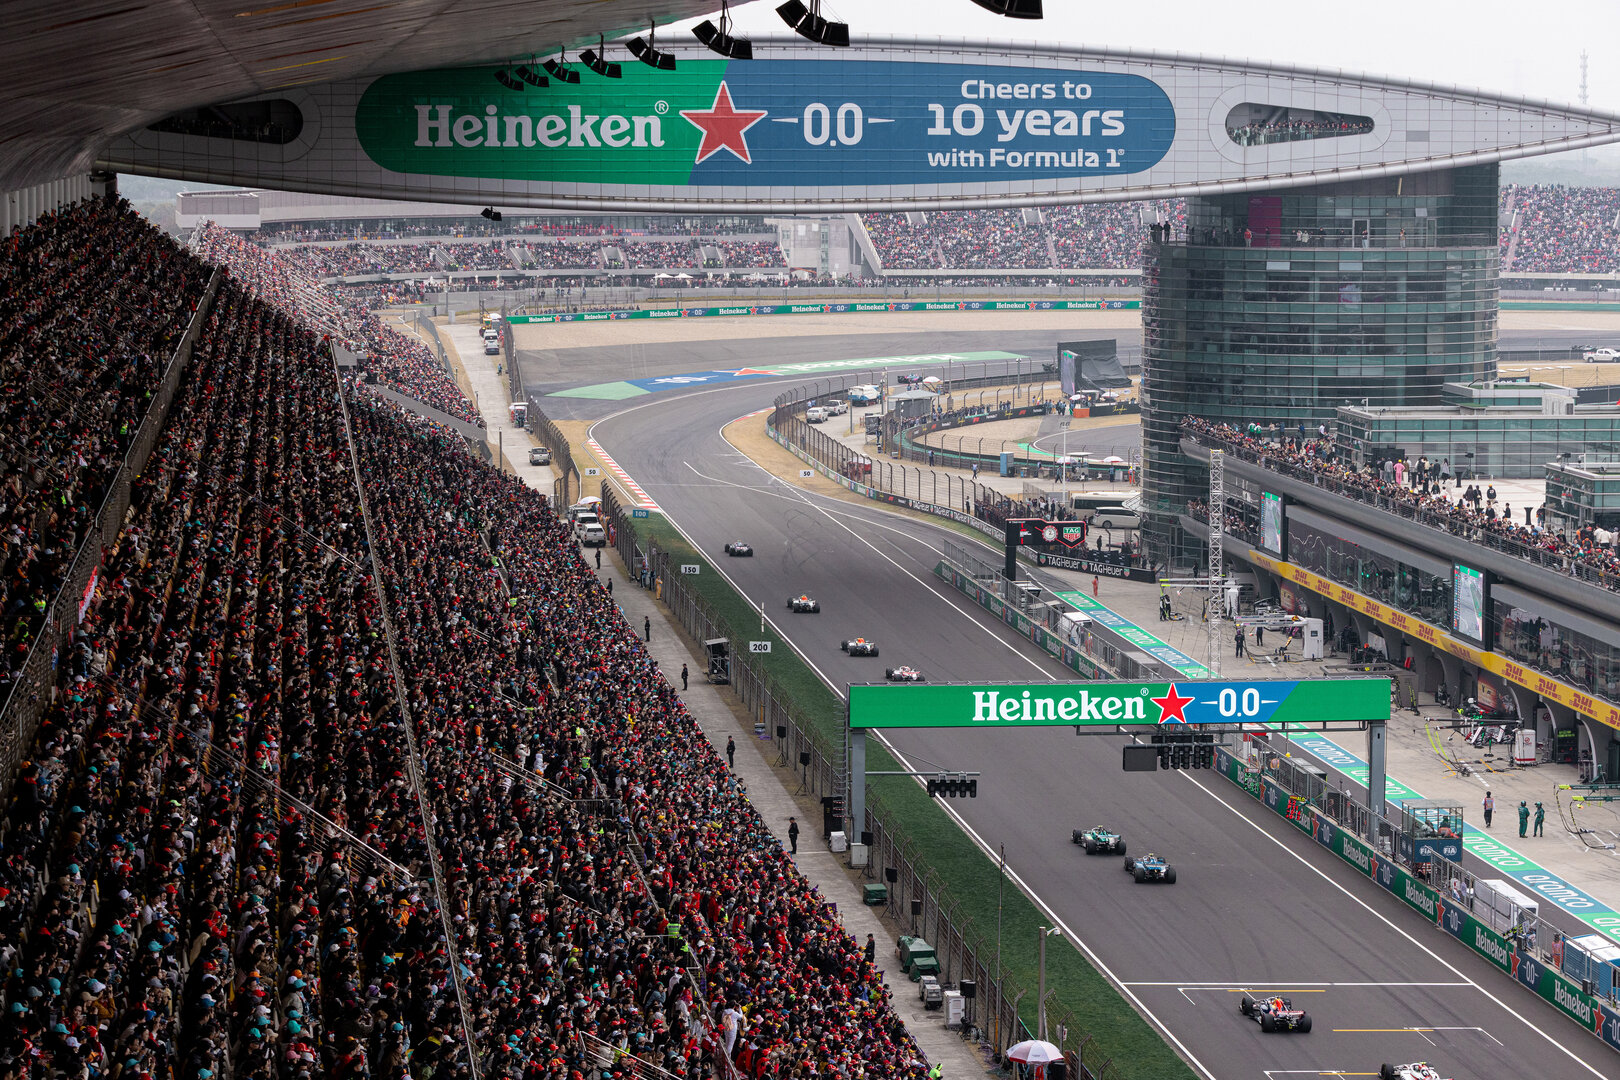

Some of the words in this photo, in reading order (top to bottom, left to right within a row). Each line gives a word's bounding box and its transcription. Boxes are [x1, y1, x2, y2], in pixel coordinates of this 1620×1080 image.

[960, 79, 1056, 100] Cheers
[1062, 81, 1092, 100] to
[927, 104, 987, 136] 10
[997, 110, 1125, 142] years
[927, 149, 984, 167] with
[990, 149, 1099, 167] Formula
[752, 642, 768, 651] 200
[1303, 740, 1356, 764] aramco
[1463, 836, 1526, 866] aramco
[1522, 874, 1595, 908] aramco
